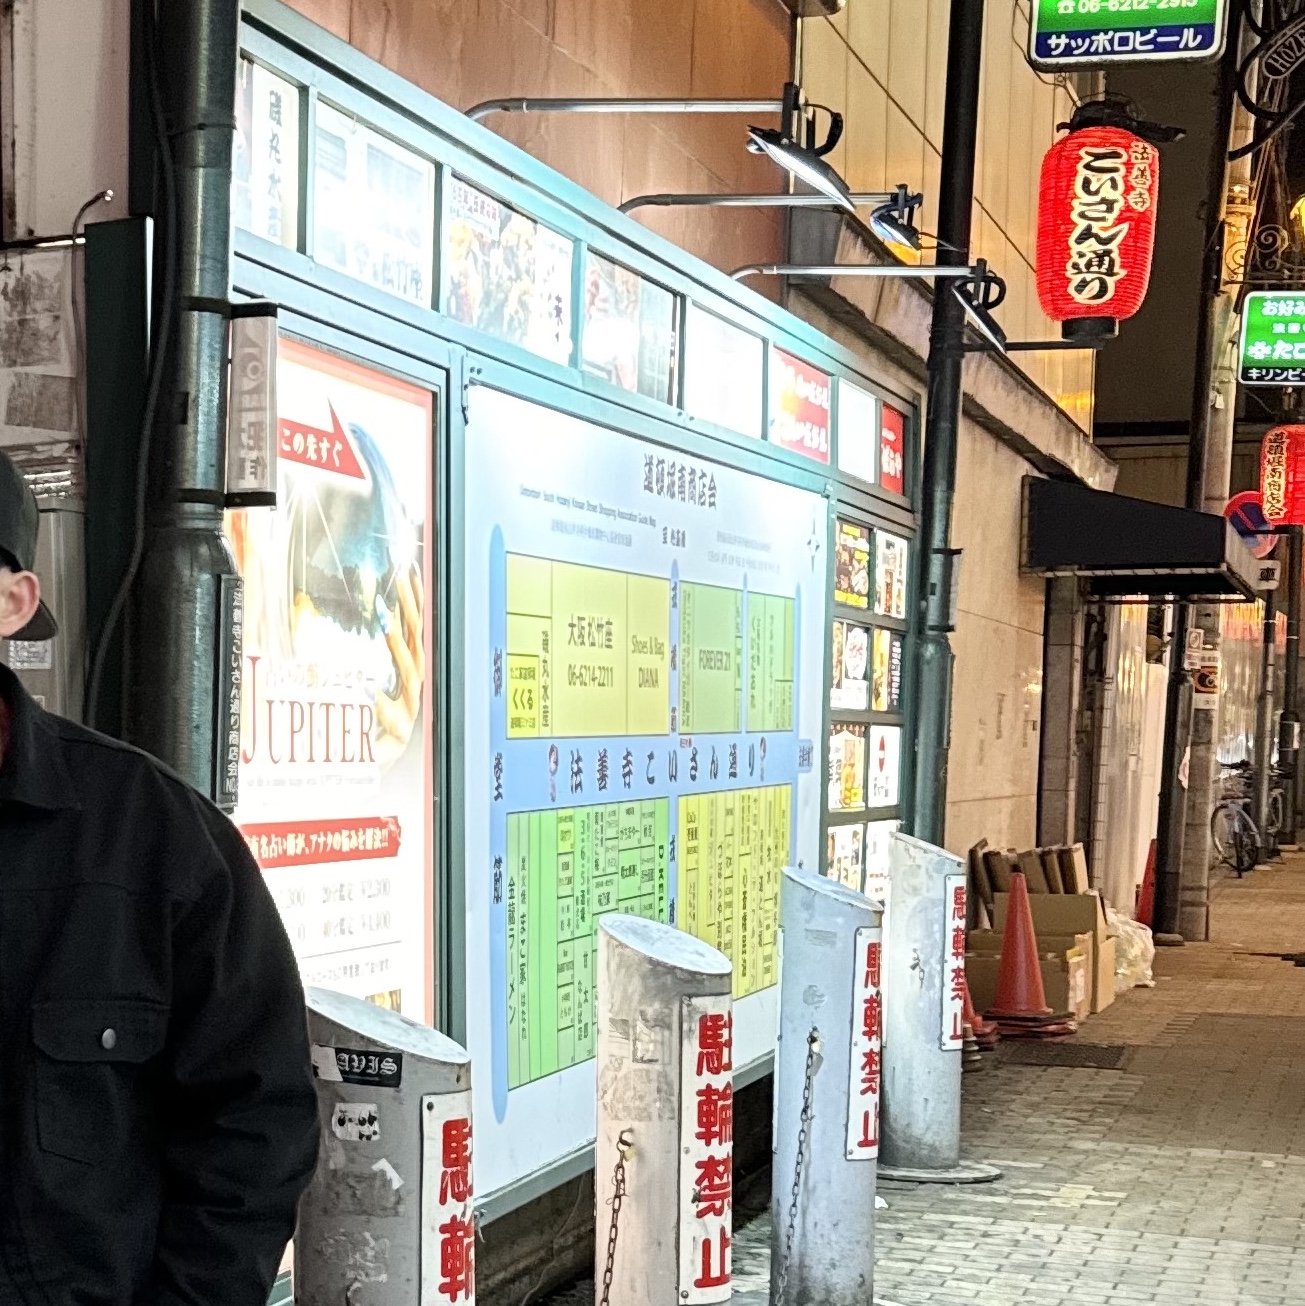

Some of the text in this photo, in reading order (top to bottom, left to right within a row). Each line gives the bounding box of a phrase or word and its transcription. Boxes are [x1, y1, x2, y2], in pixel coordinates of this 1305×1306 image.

[1048, 28, 1202, 55] サッポロビール
[1132, 143, 1152, 210] 法善寺
[1070, 149, 1128, 301] こいさん通り
[1248, 367, 1305, 380] キリンビ
[281, 427, 344, 468] この先すぐ
[242, 655, 376, 765] JUPITER
[512, 687, 534, 710] くくる
